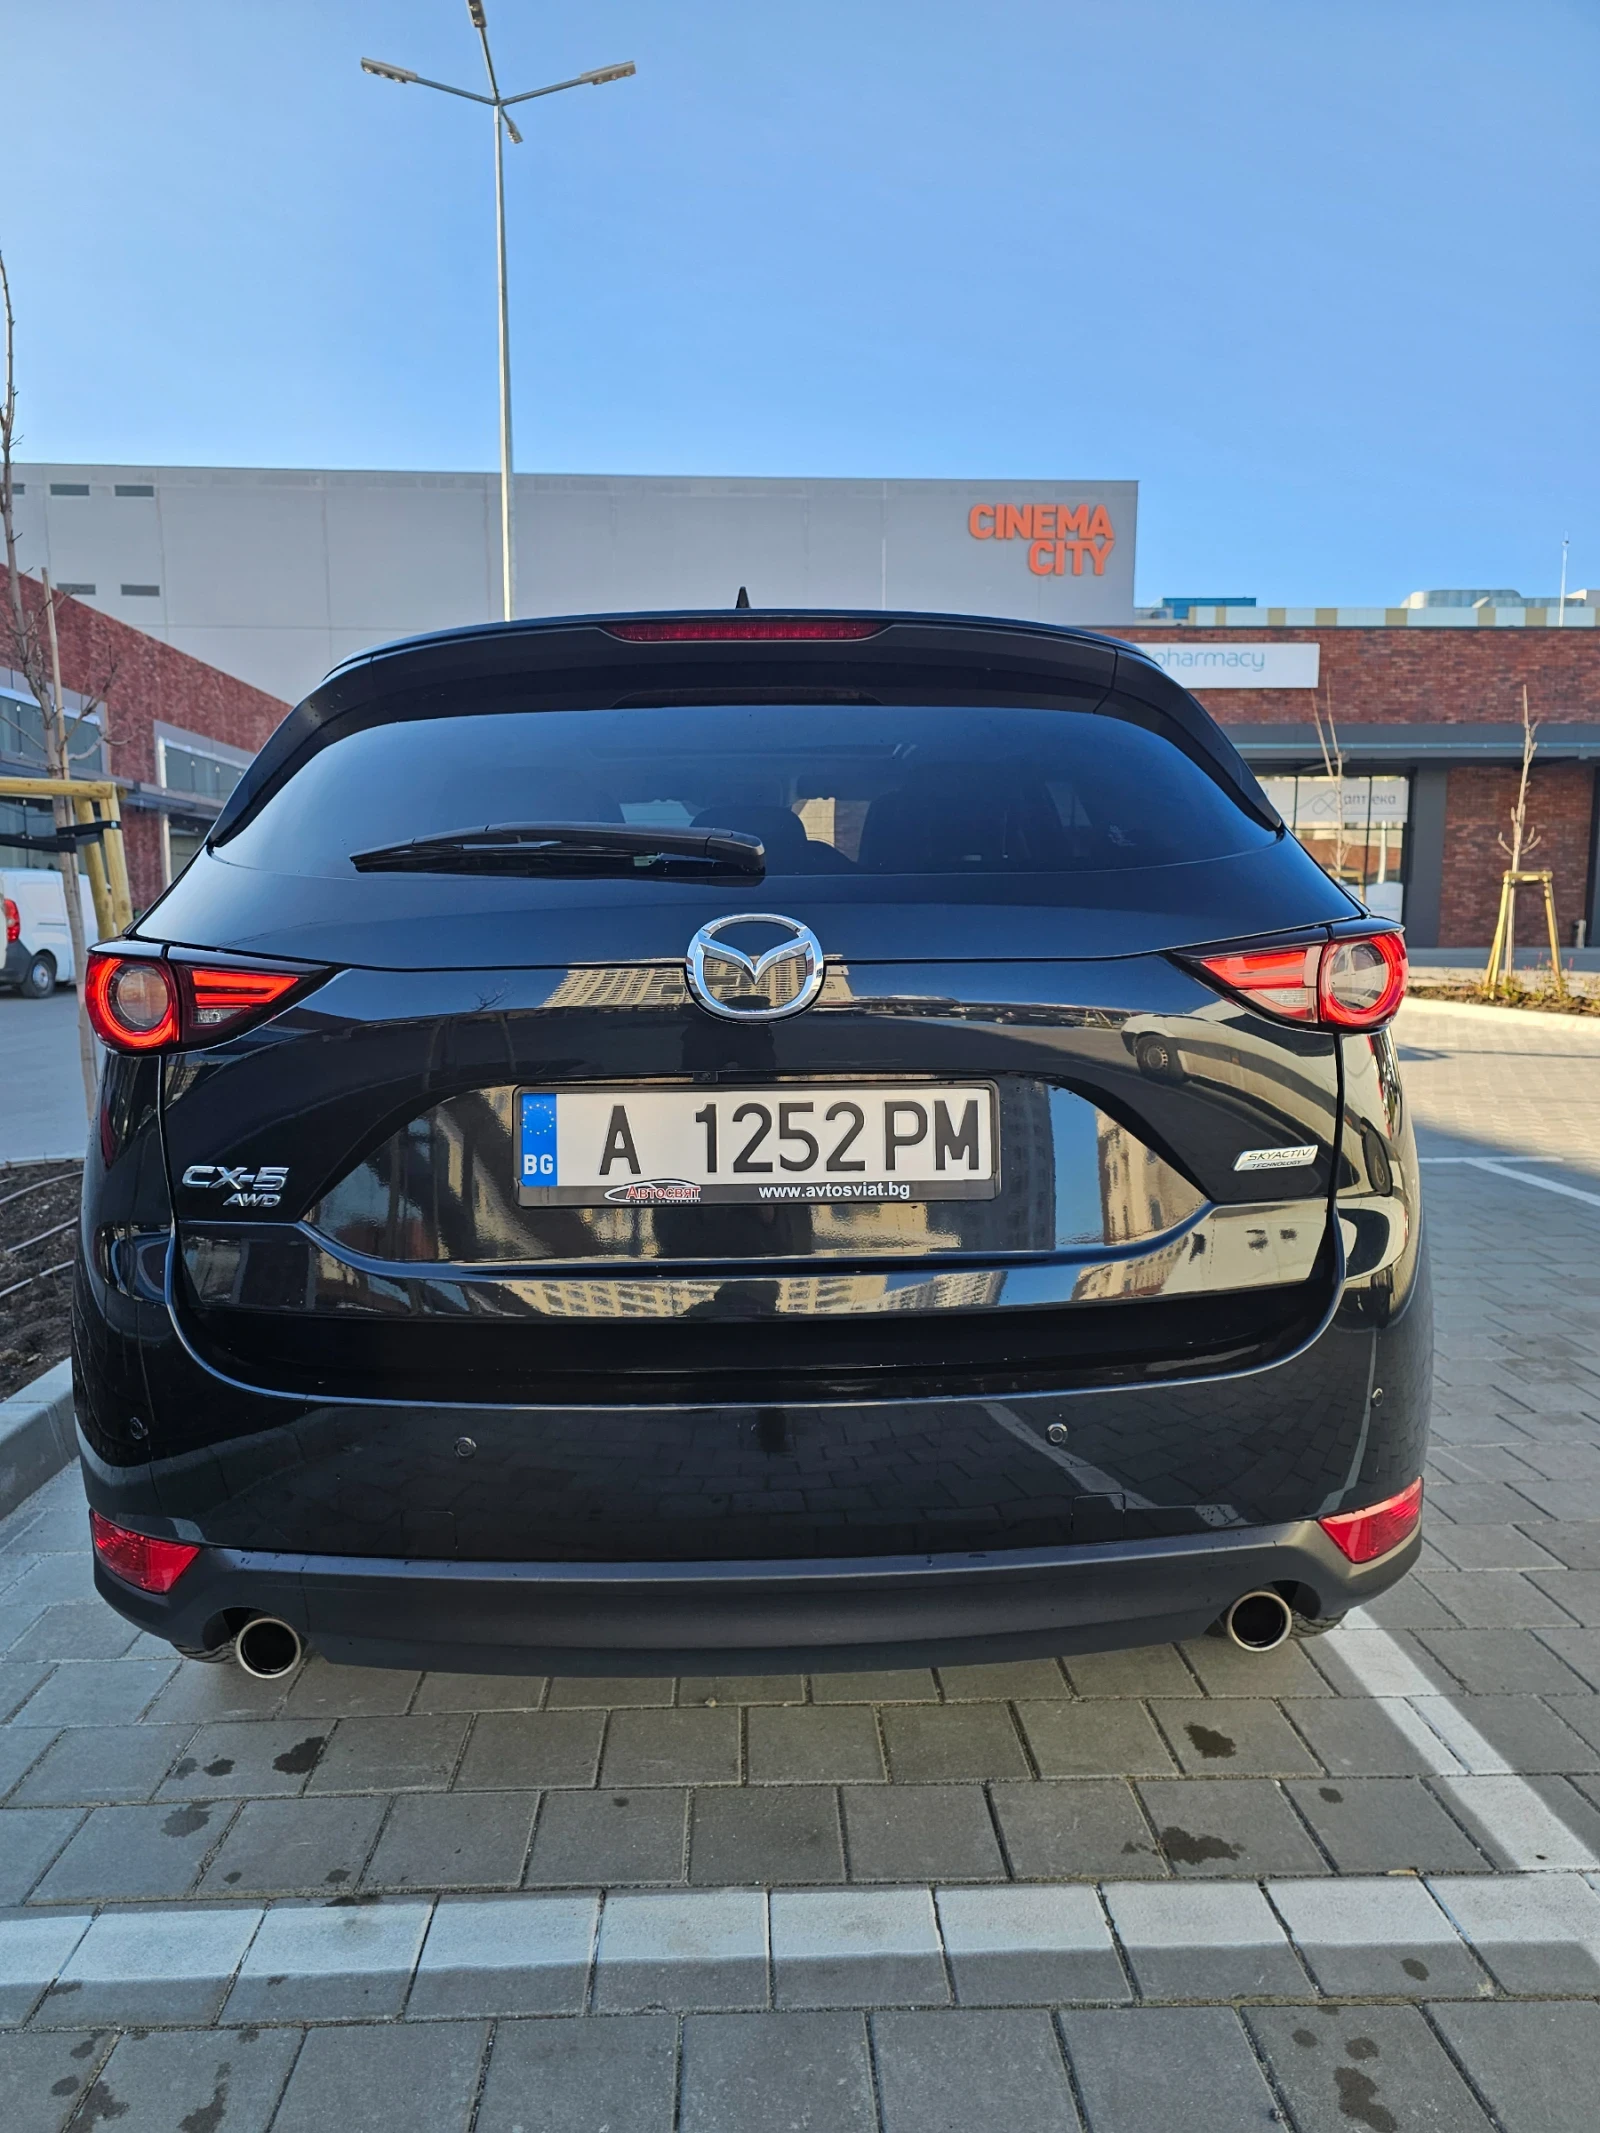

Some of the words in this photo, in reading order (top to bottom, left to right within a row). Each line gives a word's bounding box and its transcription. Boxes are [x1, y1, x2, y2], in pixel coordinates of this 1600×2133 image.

[968, 503, 1115, 540] CINEMA
[1029, 539, 1115, 575] CITY
[599, 1105, 642, 1176] A
[695, 1101, 866, 1173] 1252
[885, 1100, 979, 1170] PM
[523, 1154, 554, 1175] BG
[1247, 1148, 1310, 1161] SKYACTIV
[1252, 1160, 1302, 1168] TECHNOLOGY
[182, 1165, 290, 1191] CX-5
[222, 1193, 281, 1207] AWD
[758, 1181, 910, 1199] www.avtosviat.bg
